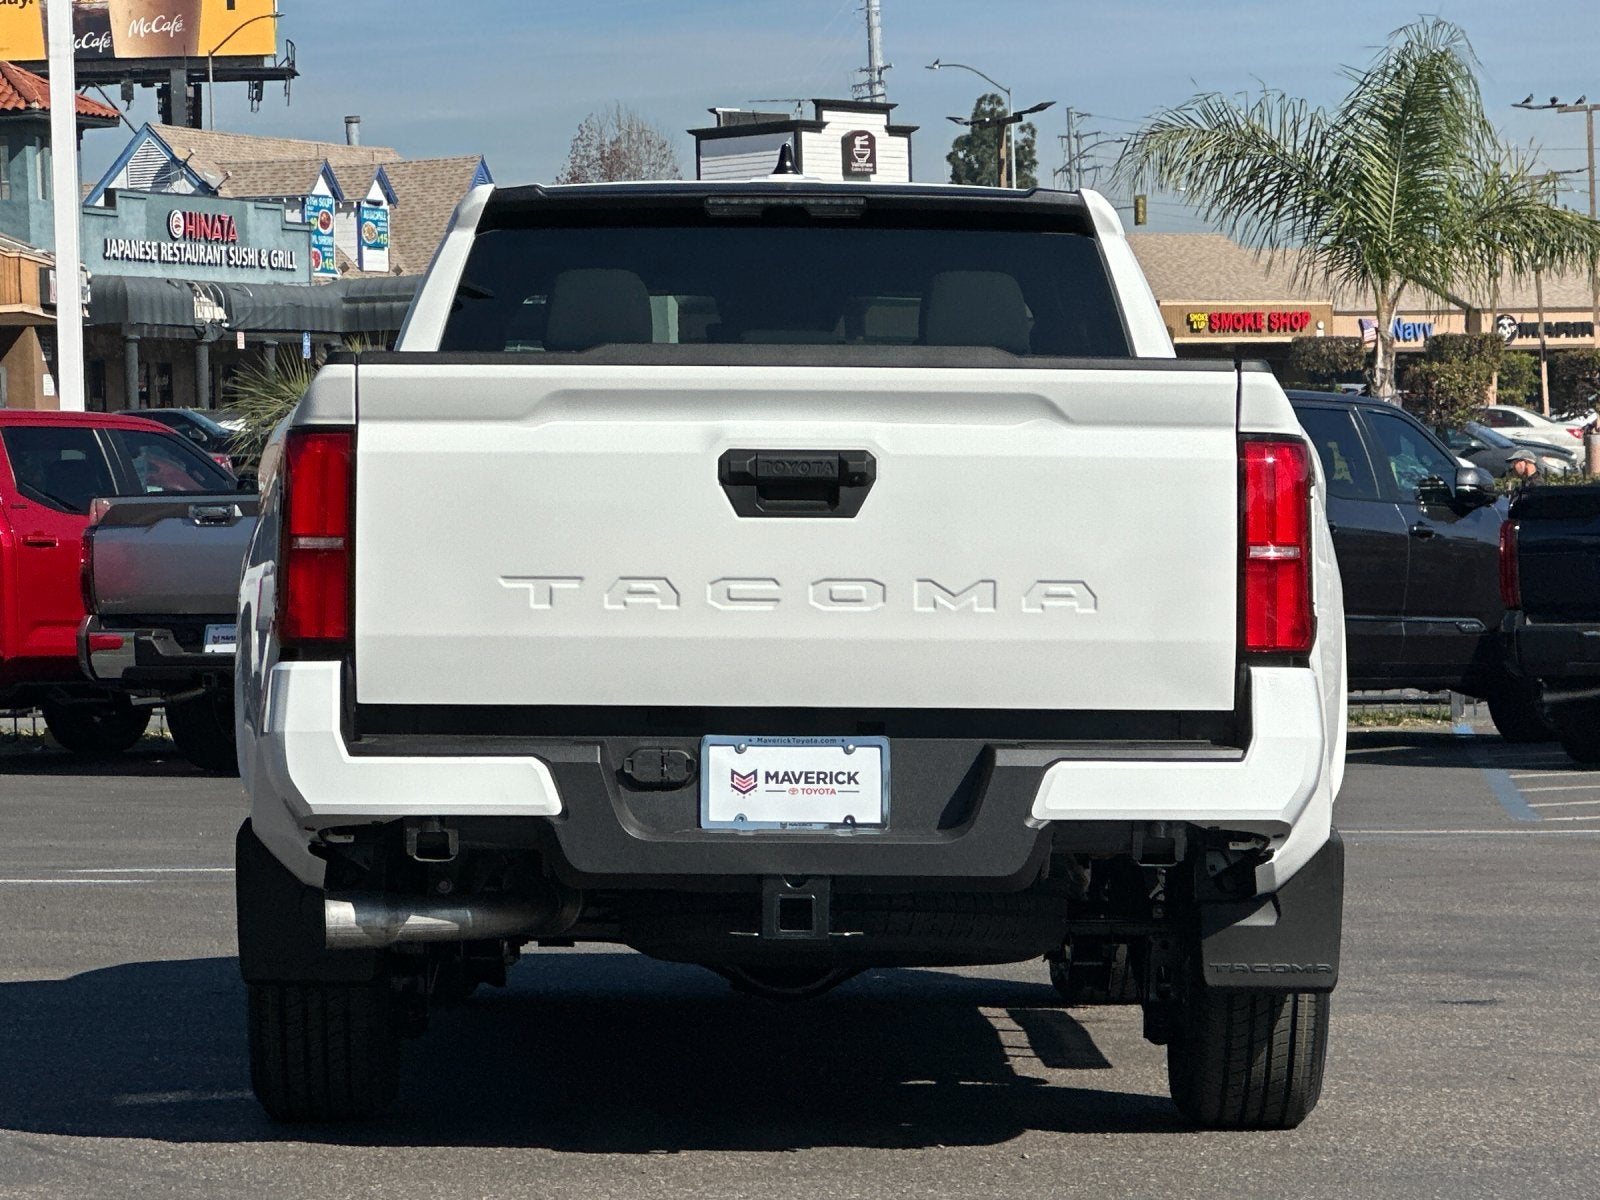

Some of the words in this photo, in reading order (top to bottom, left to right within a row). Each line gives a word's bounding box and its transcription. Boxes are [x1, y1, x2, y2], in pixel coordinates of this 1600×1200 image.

[128, 14, 184, 38] McCafé
[72, 30, 112, 53] cCafé
[185, 211, 239, 241] HINATA
[105, 238, 158, 260] JAPANESE
[161, 242, 227, 264] RESTAURANT
[229, 246, 259, 266] SUSHI
[260, 249, 269, 266] &
[270, 249, 298, 269] GRILL
[1210, 311, 1265, 330] SMOKE
[1269, 311, 1311, 330] SHOP
[1392, 317, 1434, 341] Navy
[761, 460, 835, 475] TOYOTA
[498, 575, 1099, 615] TACOMA
[764, 770, 860, 785] MAVERICK
[1209, 962, 1333, 974] TACOMA
